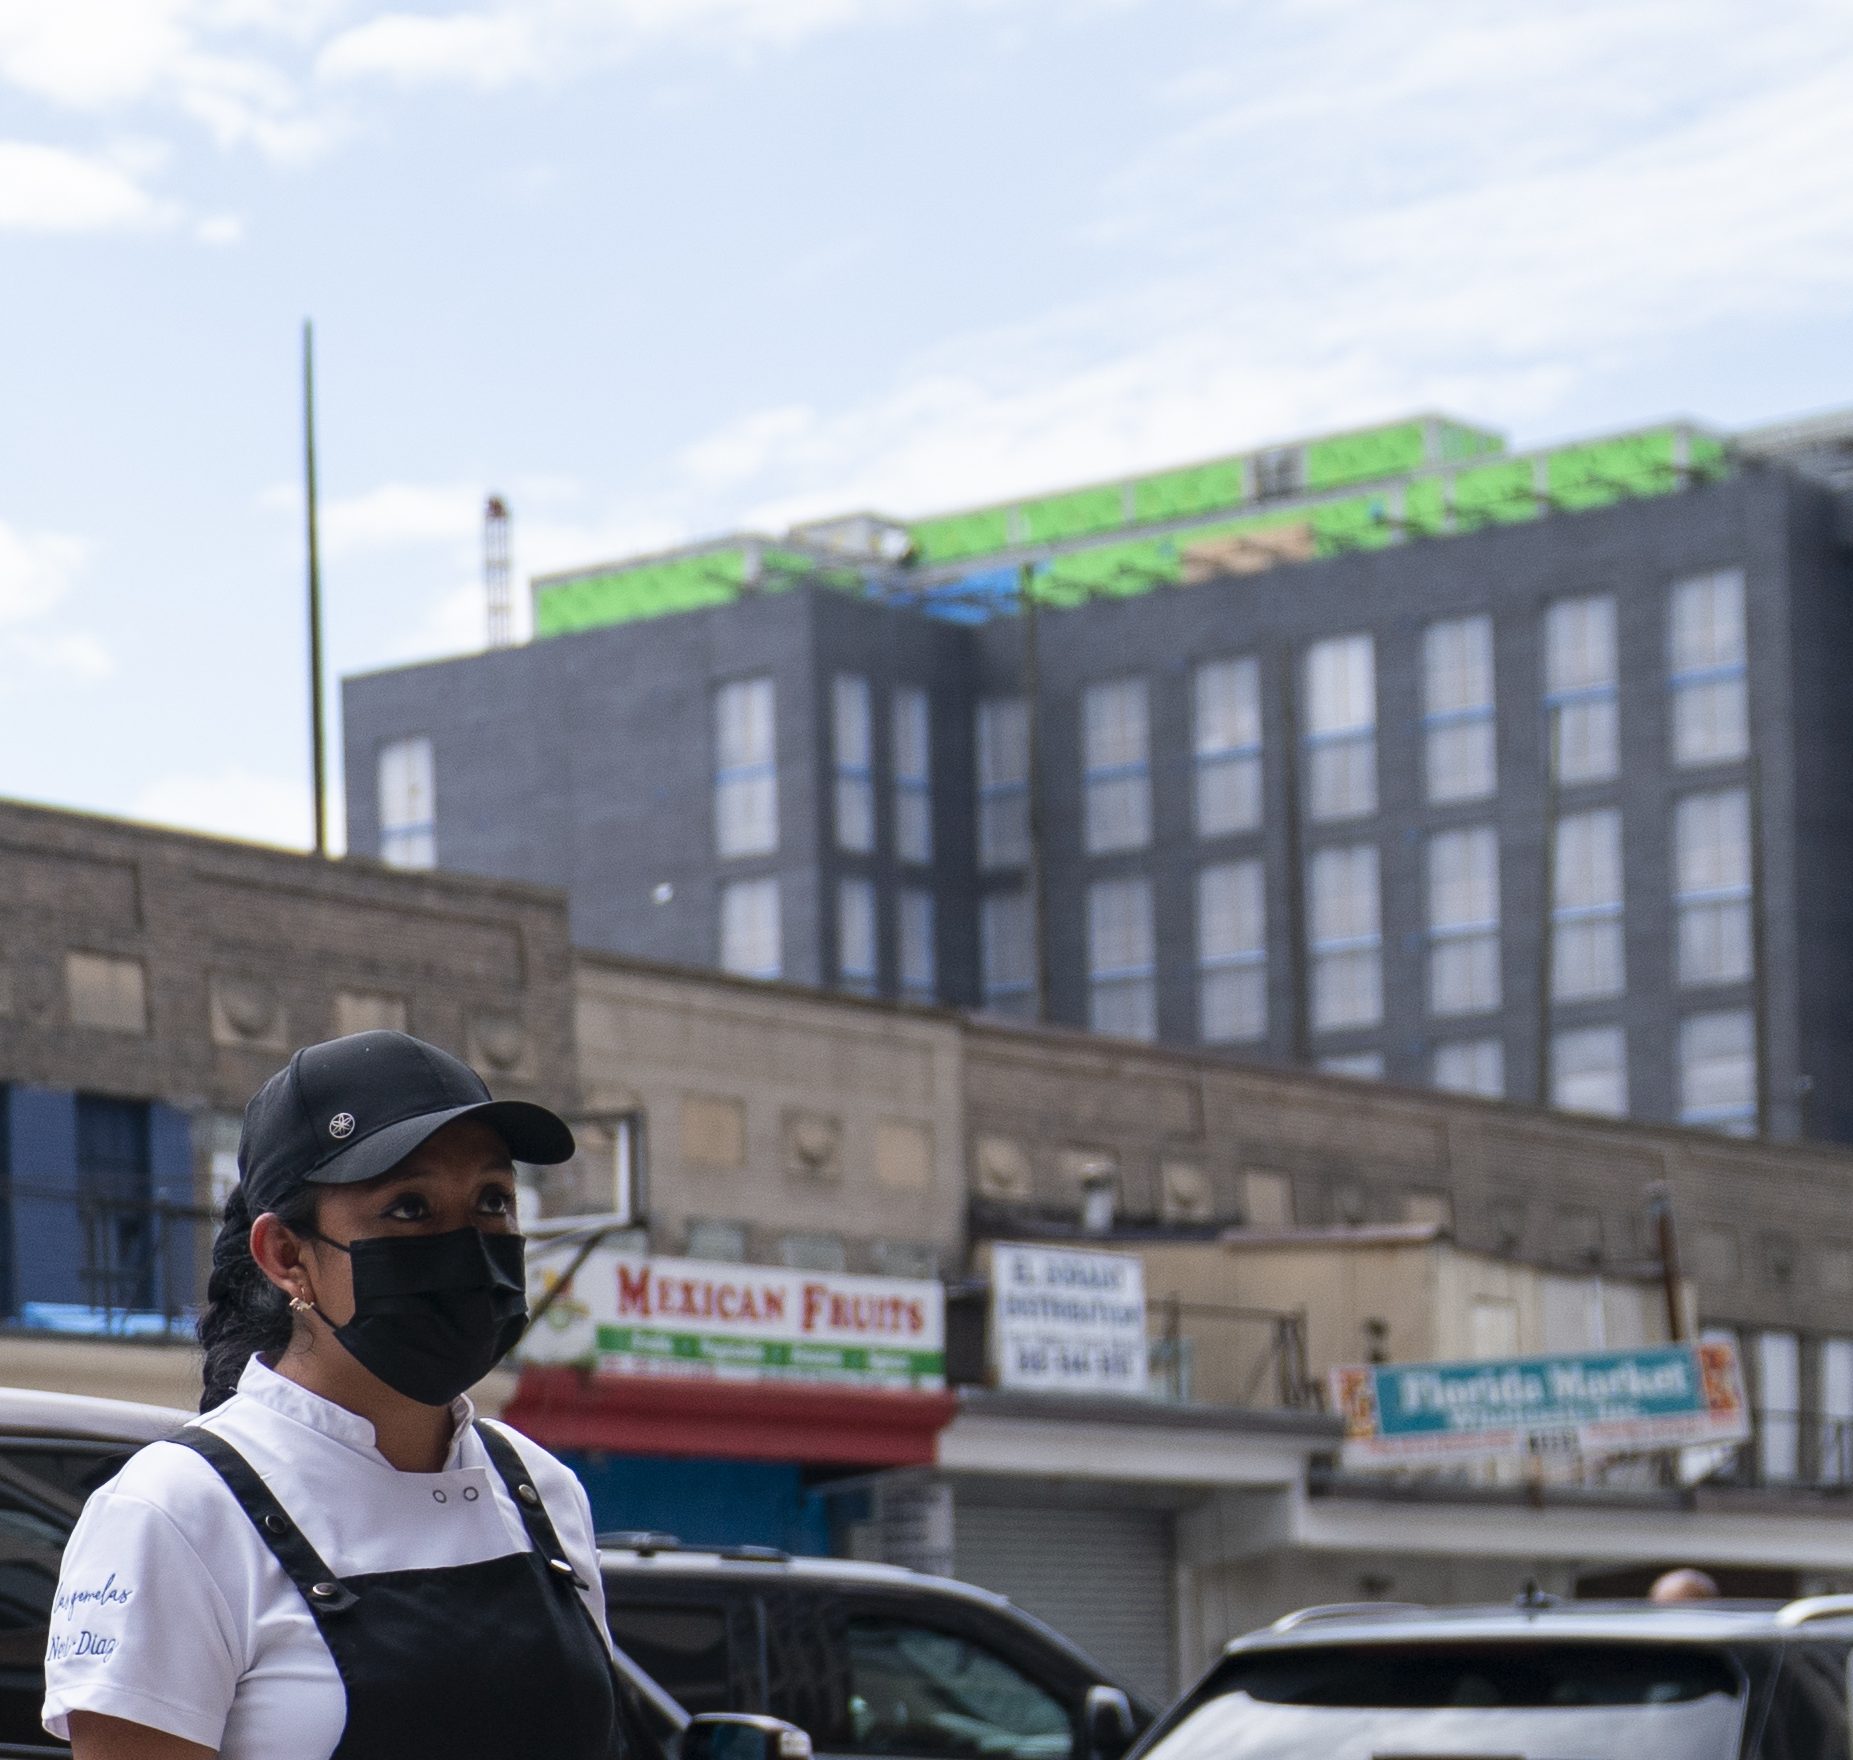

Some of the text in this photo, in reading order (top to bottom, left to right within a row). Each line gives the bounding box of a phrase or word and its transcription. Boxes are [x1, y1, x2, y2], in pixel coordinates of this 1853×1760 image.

[615, 1263, 926, 1336] MEXICAN FRUITS
[1551, 1359, 1687, 1398] Market
